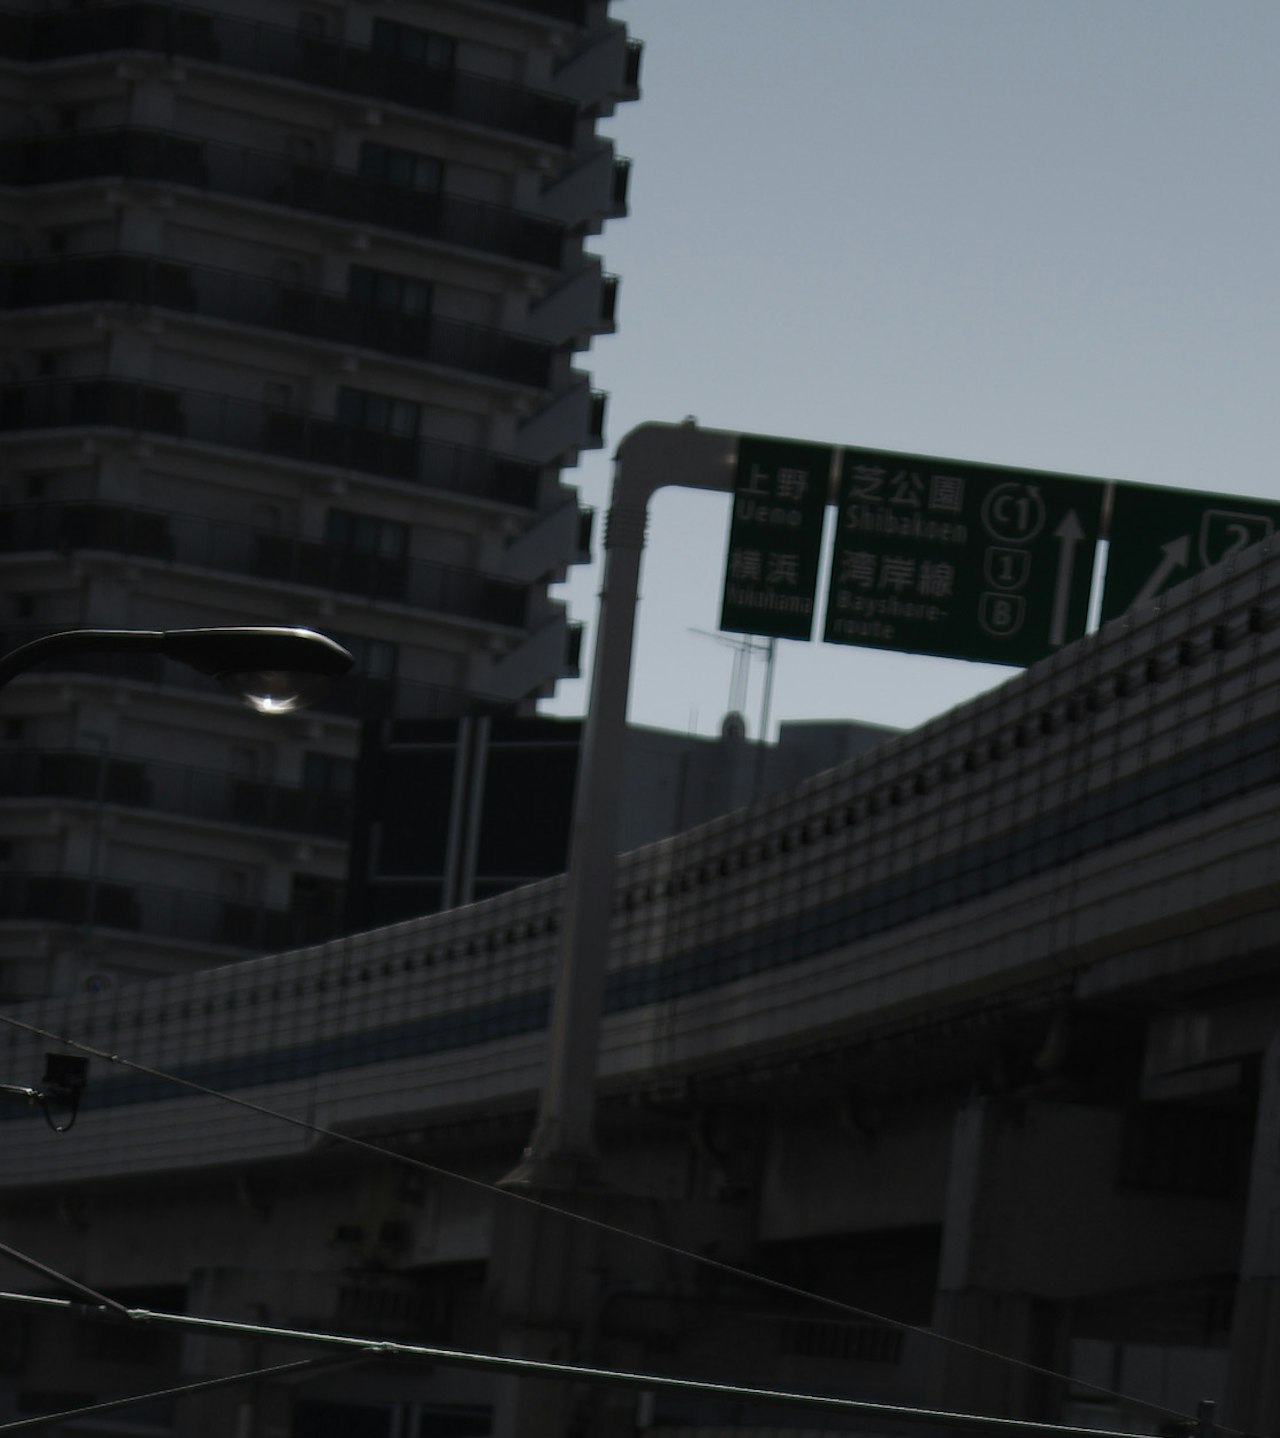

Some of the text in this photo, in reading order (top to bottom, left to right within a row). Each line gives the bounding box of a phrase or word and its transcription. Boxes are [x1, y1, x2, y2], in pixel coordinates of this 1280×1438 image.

[737, 462, 810, 501] 上野
[849, 464, 966, 514] 芝公園
[736, 500, 803, 527] Ueno
[846, 504, 968, 545] Shibakoen
[992, 494, 1030, 532] C1
[1221, 524, 1250, 562] 2
[730, 548, 800, 585] 横浜
[839, 549, 956, 597] 湾岸線
[1000, 556, 1013, 579] 1
[727, 583, 813, 615] Yokohama
[992, 600, 1012, 625] B
[832, 619, 896, 640] route
